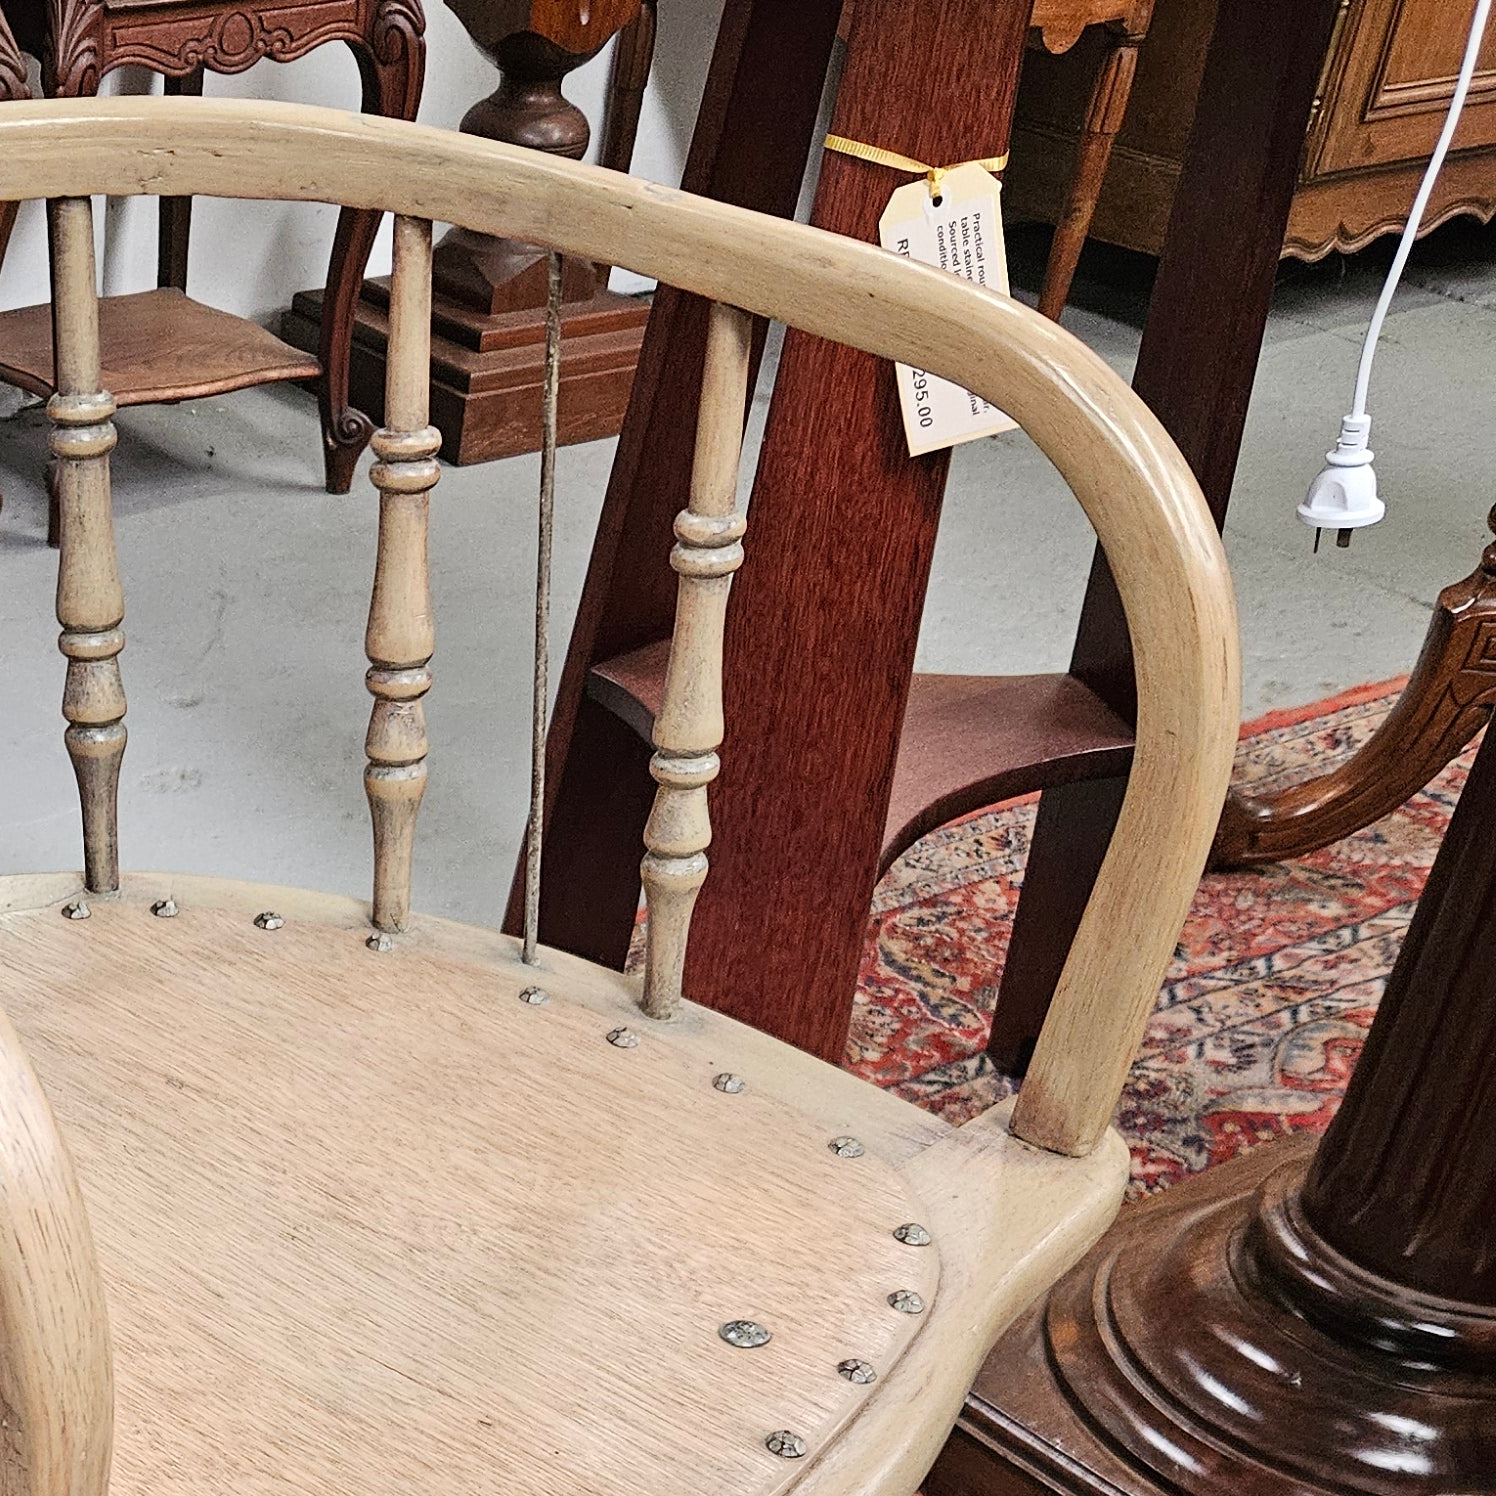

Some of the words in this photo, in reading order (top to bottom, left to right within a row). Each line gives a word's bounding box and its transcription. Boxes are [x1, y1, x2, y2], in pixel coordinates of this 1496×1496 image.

[948, 220, 961, 267] Sourced
[960, 216, 971, 246] table
[973, 212, 985, 262] Practical
